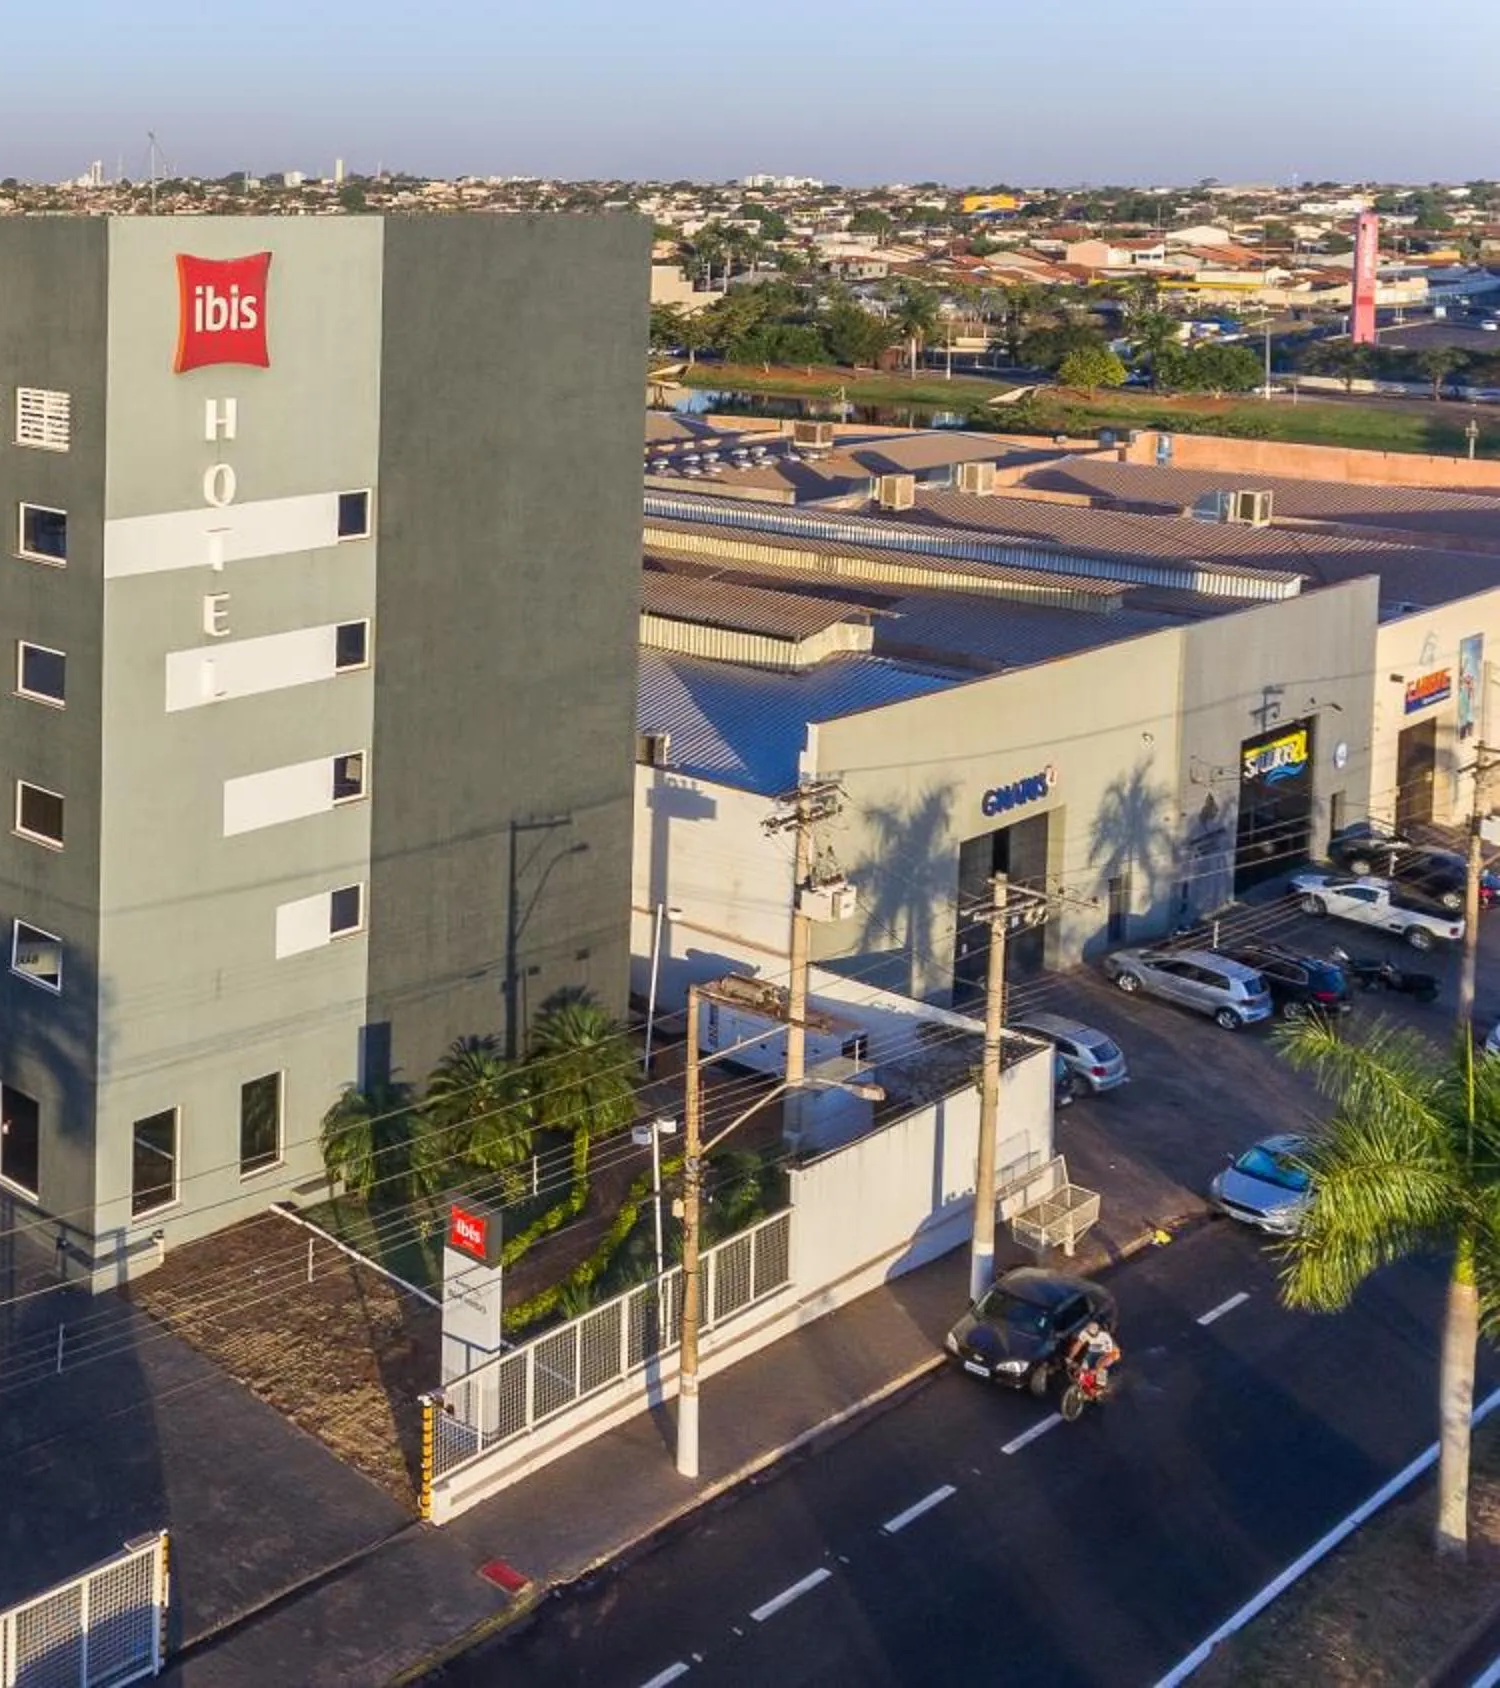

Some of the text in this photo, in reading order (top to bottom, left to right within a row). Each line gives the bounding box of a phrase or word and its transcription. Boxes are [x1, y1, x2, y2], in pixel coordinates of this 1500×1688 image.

[194, 284, 258, 333] ibis
[199, 397, 238, 700] HOTEL
[456, 1217, 482, 1245] ibis
